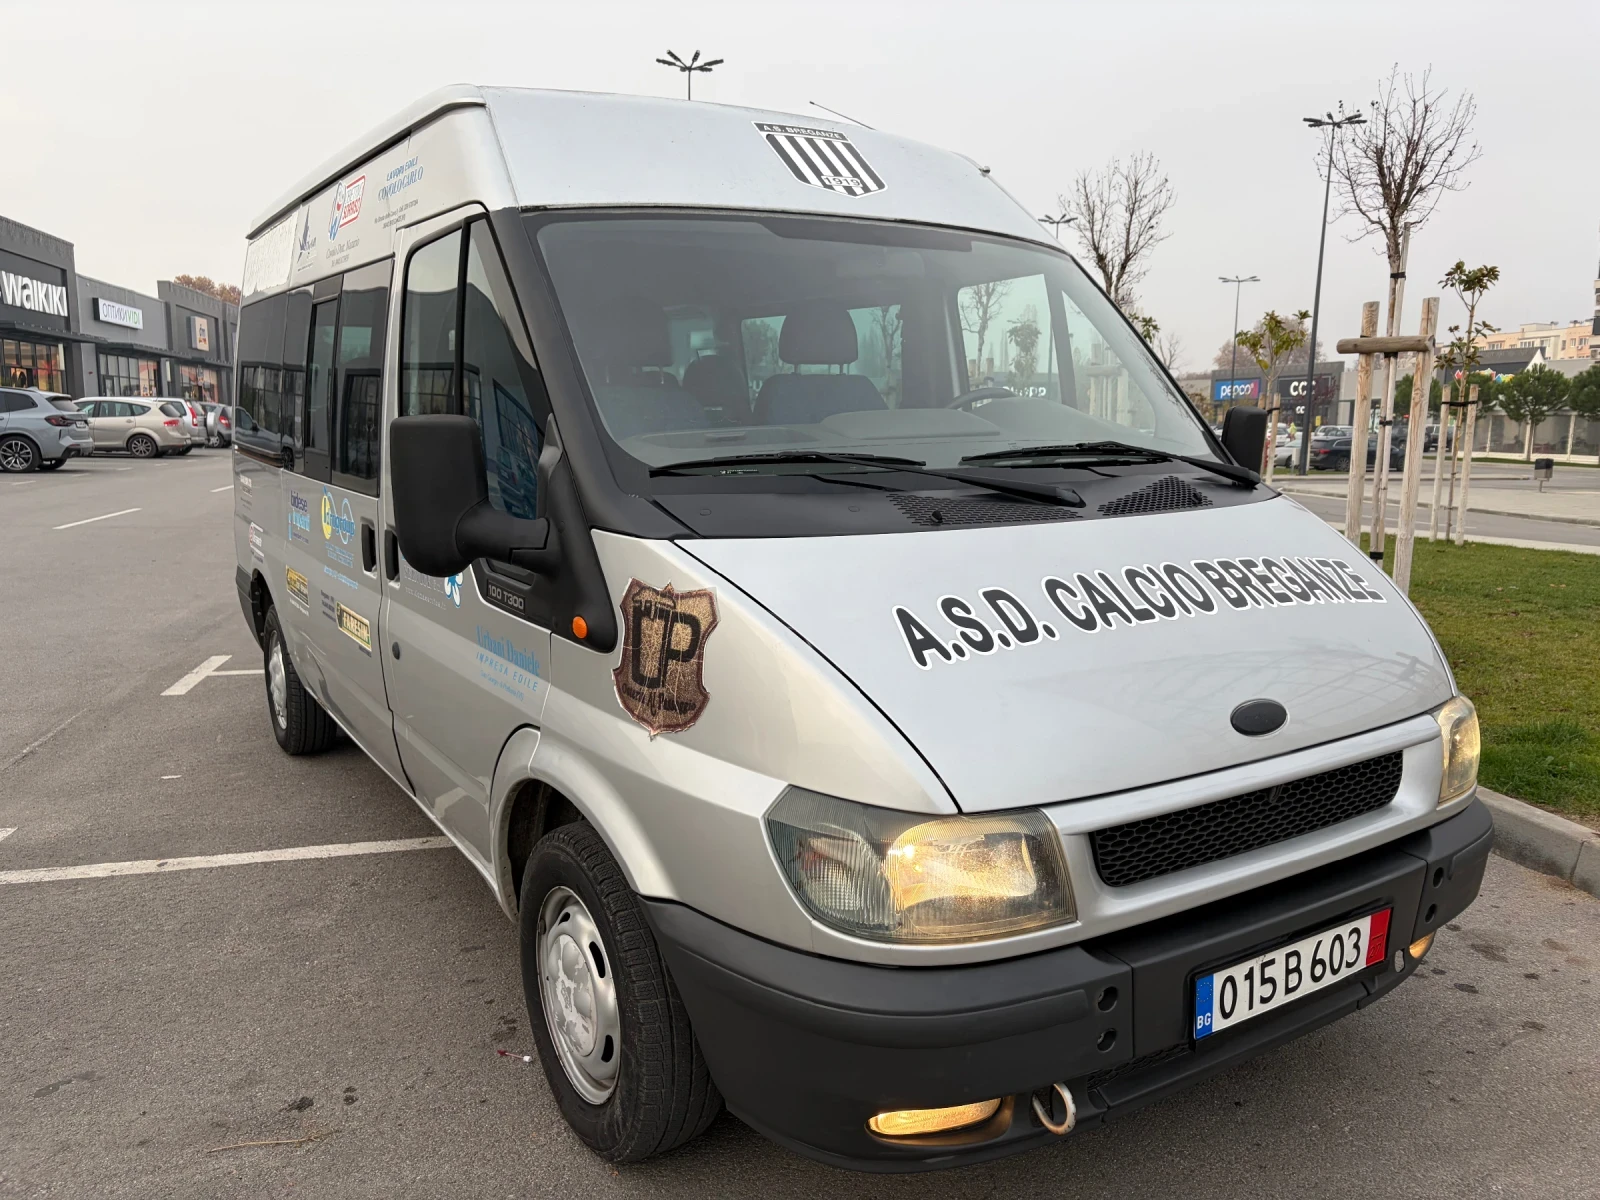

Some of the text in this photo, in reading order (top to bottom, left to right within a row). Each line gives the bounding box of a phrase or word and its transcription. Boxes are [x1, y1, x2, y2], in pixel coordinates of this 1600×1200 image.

[786, 126, 844, 140] BREGANZE
[895, 558, 1386, 668] A.S.D. CALCIO BREGANZE
[476, 625, 540, 677] Urbani Daniele
[476, 651, 539, 692] IMPRESA EDILE
[1197, 1013, 1212, 1030] BG
